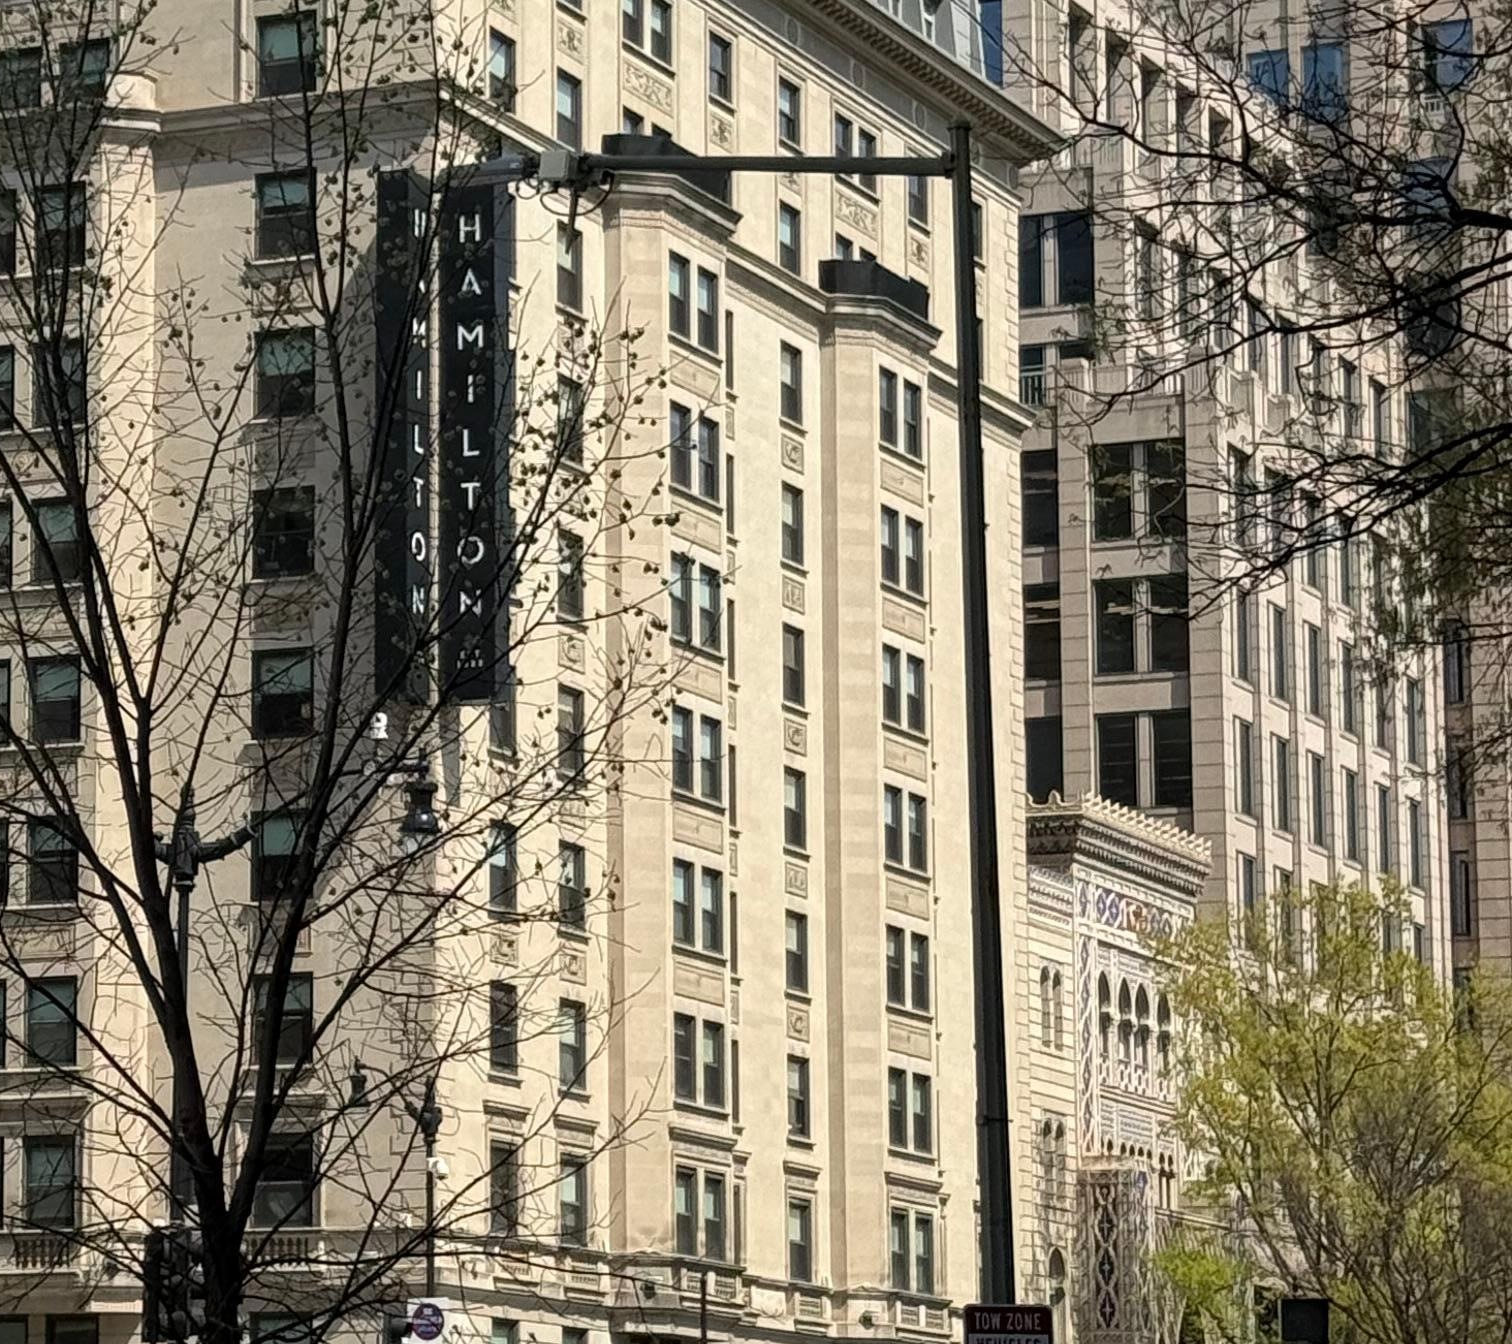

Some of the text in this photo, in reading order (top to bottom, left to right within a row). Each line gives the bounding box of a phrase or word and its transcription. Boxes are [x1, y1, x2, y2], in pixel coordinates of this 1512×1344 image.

[456, 214, 486, 615] HAMILTON
[974, 1312, 1041, 1331] TOW ZONE
